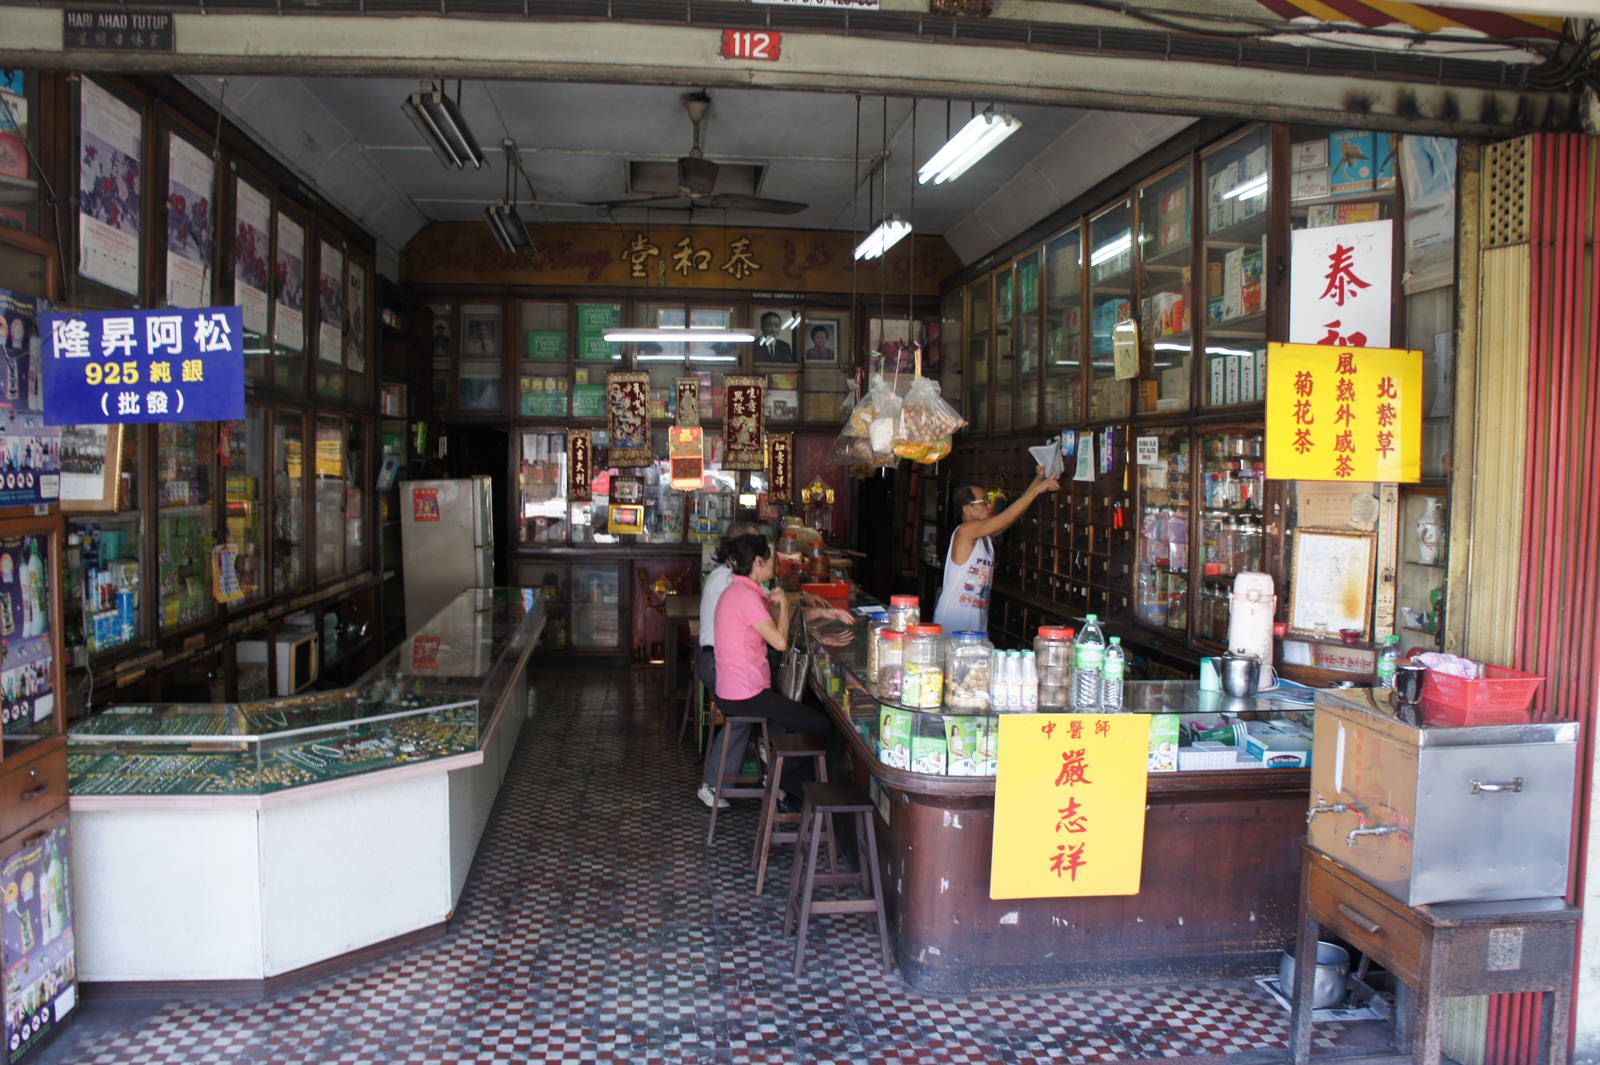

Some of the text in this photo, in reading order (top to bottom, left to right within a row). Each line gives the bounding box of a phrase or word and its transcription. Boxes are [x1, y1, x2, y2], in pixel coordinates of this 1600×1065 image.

[68, 13, 168, 29] HARI AHAD TUTUP
[733, 32, 770, 58] 112
[52, 313, 232, 359] 隆昇阿松
[85, 360, 204, 385] 925 純銀
[101, 389, 184, 416] (批發)
[1292, 370, 1315, 455] 菊花茶
[1333, 353, 1357, 479] 風熱外感茶
[1375, 376, 1399, 459] 北紫草
[1041, 719, 1111, 739] 中醫師
[1049, 748, 1094, 882] 嚴志祥
